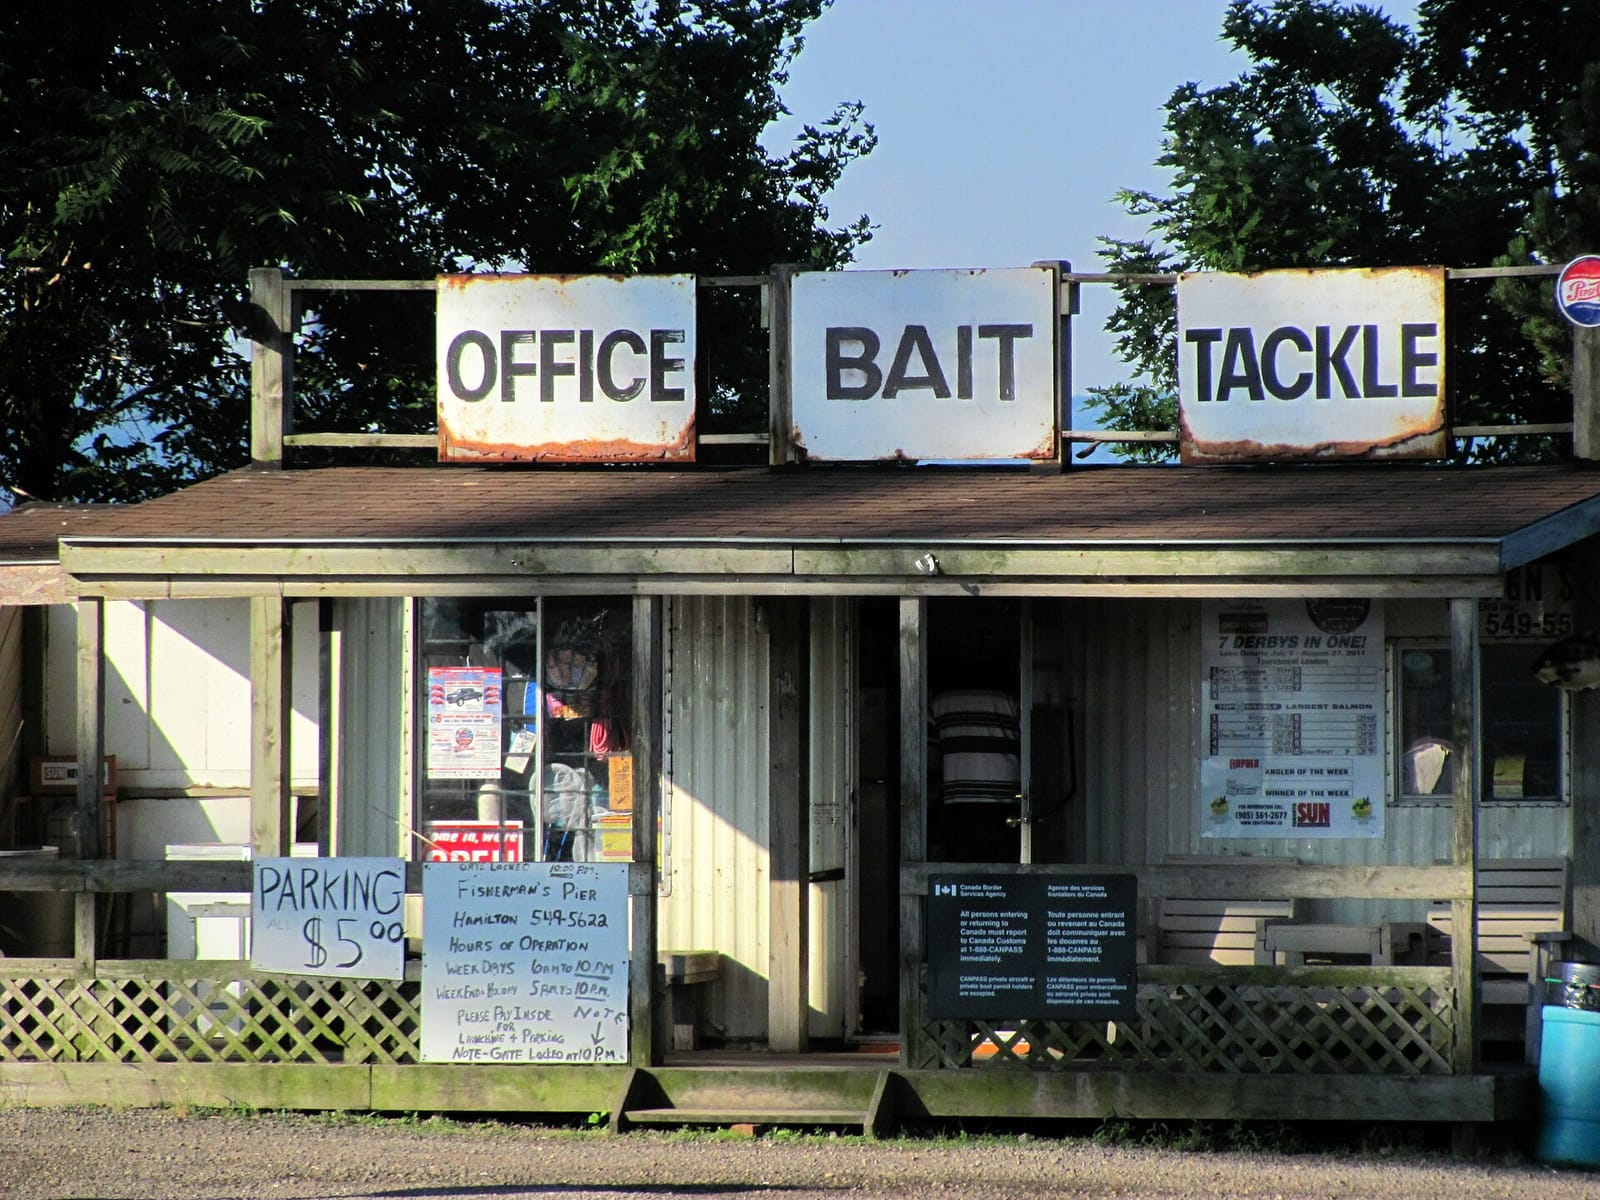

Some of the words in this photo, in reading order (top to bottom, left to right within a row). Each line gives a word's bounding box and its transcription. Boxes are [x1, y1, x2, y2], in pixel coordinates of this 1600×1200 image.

[446, 329, 685, 403] OFFICE
[826, 324, 1033, 401] BAIT
[1186, 322, 1438, 402] TACKLE
[1219, 636, 1230, 649] 7
[1233, 635, 1299, 649] DERBYS
[1304, 635, 1322, 649] IN
[1326, 635, 1368, 649] ONE!
[1297, 789, 1307, 797] OF
[1311, 789, 1325, 797] THE
[1328, 789, 1349, 797] WEEK
[1298, 803, 1330, 822] SUN
[260, 867, 403, 914] PARKING
[985, 891, 1007, 899] Agency
[529, 909, 609, 928] 549-5622
[971, 911, 999, 920] persons
[1000, 911, 1029, 920] entering
[1067, 911, 1099, 920] personne
[1101, 911, 1125, 919] entrant
[969, 920, 1000, 928] returning
[1058, 920, 1087, 928] revenant
[960, 928, 986, 936] Canada
[1006, 929, 1027, 937] report
[1047, 928, 1060, 936] doit
[1062, 929, 1109, 938] communiquer
[450, 936, 492, 953] HOURS
[500, 941, 514, 950] OF
[519, 935, 589, 952] OPERATION
[996, 937, 1027, 945] Customs
[457, 1009, 490, 1026] PLEASE
[494, 1005, 512, 1022] PAY
[496, 1021, 516, 1032] FOR
